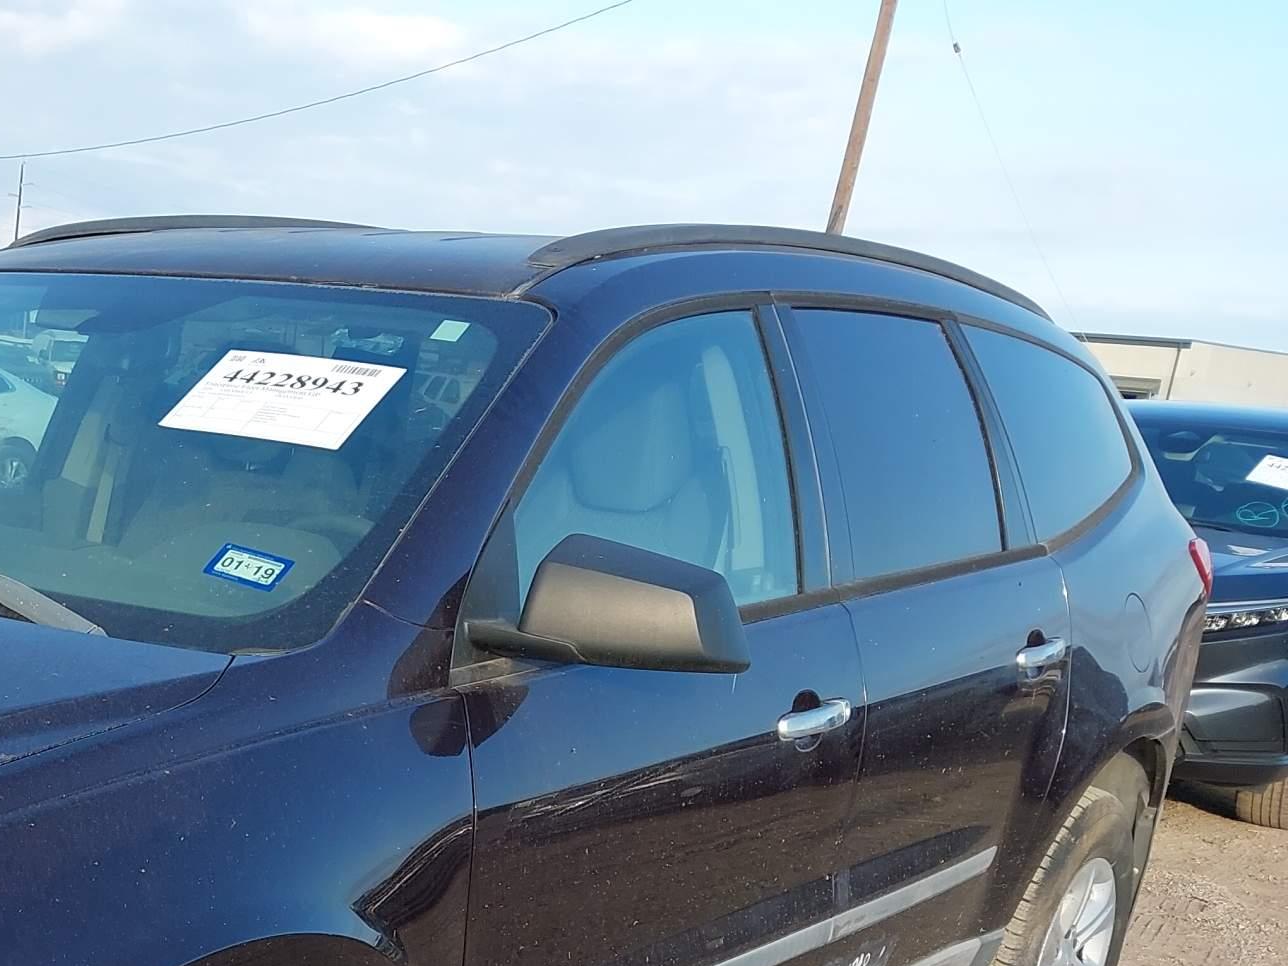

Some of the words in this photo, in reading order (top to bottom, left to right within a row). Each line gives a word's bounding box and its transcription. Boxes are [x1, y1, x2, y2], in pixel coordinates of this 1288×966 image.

[223, 368, 364, 396] 44228943
[221, 556, 243, 570] 01
[253, 565, 275, 579] 19
